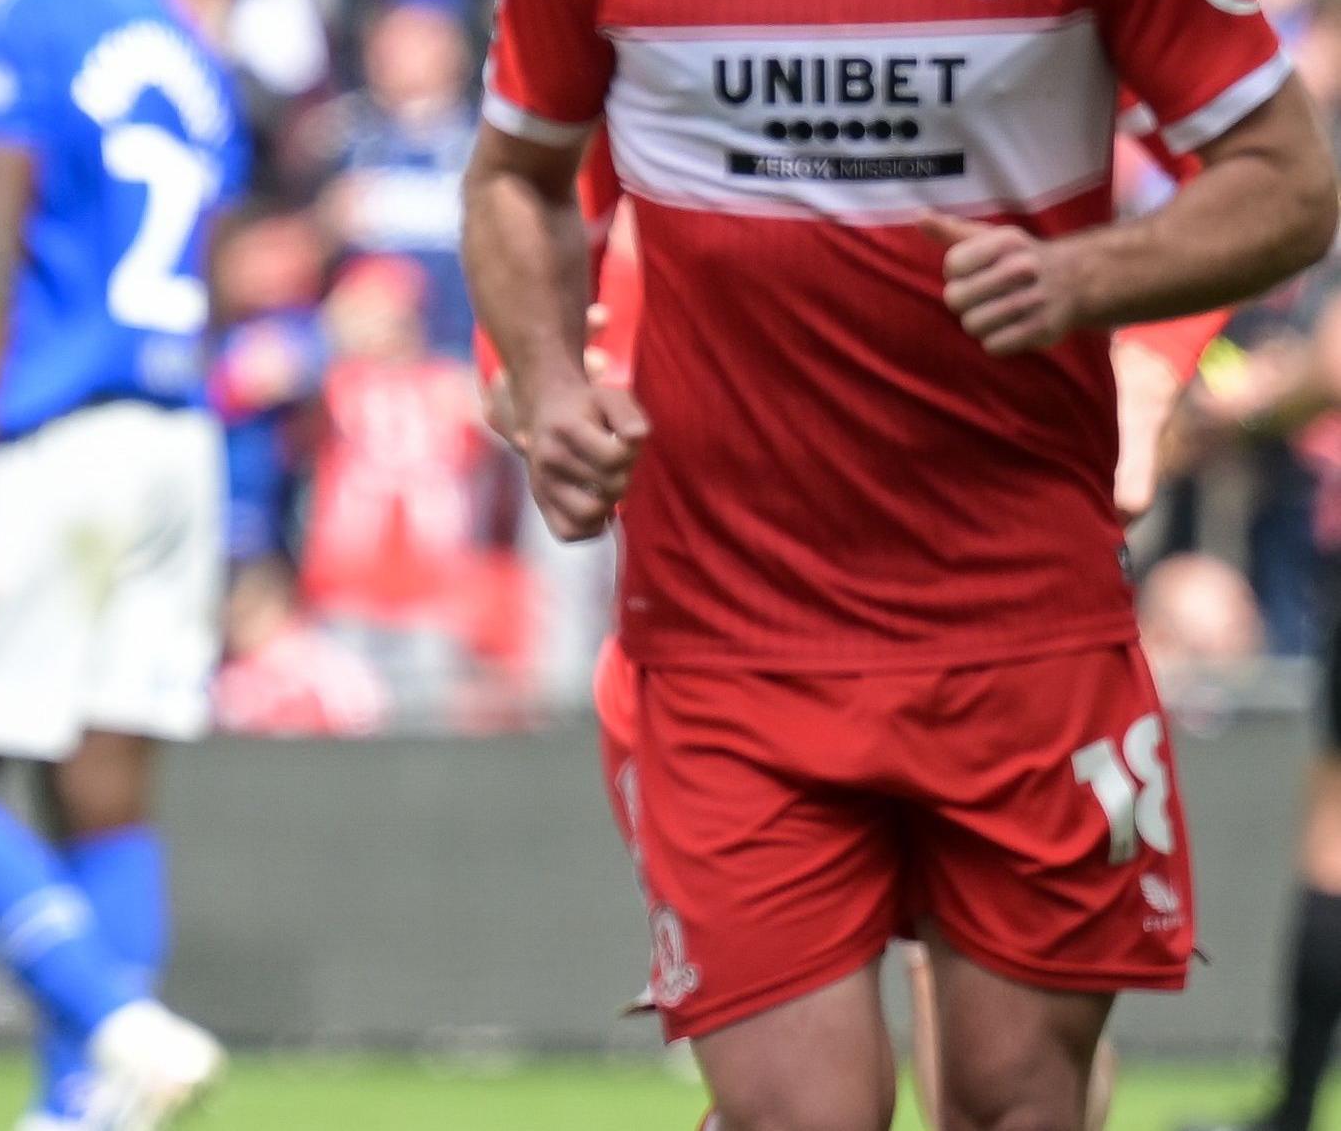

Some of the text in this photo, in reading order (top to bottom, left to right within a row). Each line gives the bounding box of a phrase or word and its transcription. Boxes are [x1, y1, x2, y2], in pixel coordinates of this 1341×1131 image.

[713, 58, 966, 105] UNIBET
[839, 158, 934, 180] MISSION
[101, 123, 210, 335] 2
